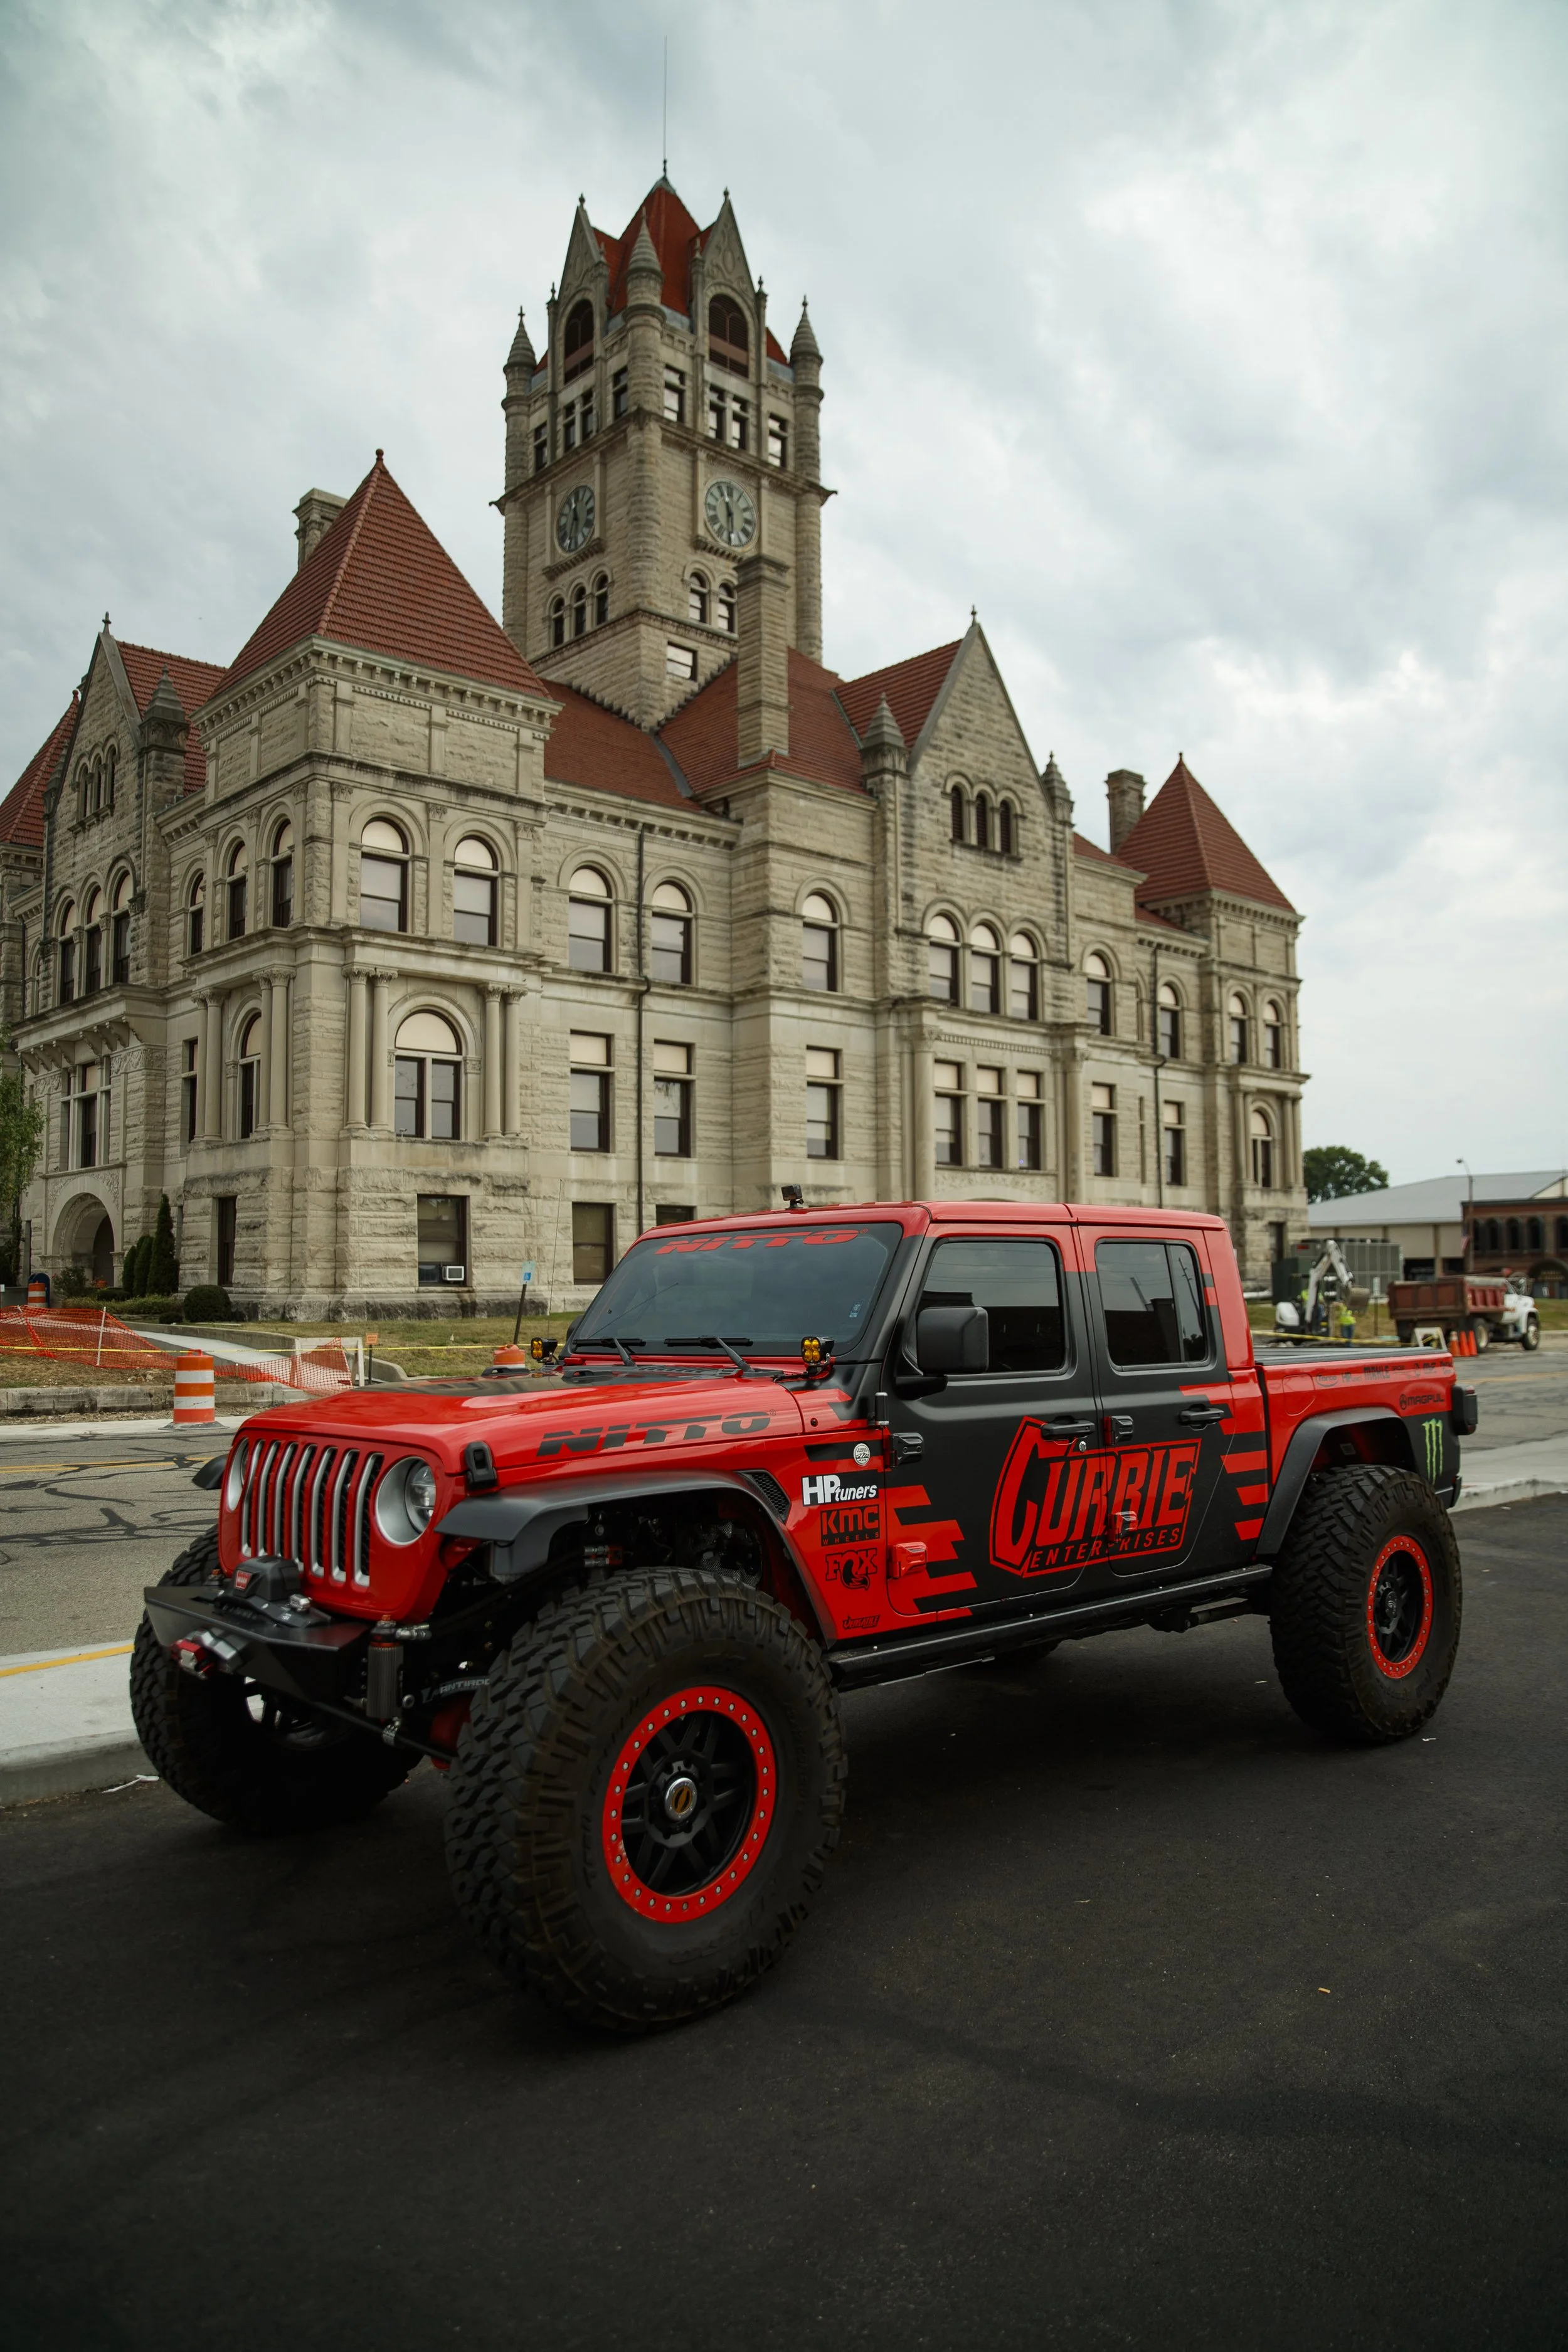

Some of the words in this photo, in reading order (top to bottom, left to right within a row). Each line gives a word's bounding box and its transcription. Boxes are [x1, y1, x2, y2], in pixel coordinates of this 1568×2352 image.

[1407, 1394, 1445, 1405] MAGPUL
[995, 1424, 1197, 1567] CURRIE
[822, 1505, 879, 1535] KMC
[823, 1532, 879, 1545] WHEELS
[1030, 1527, 1180, 1569] ENTERRISES
[825, 1547, 877, 1590] FOX
[440, 1678, 490, 1693] ANTIROC
